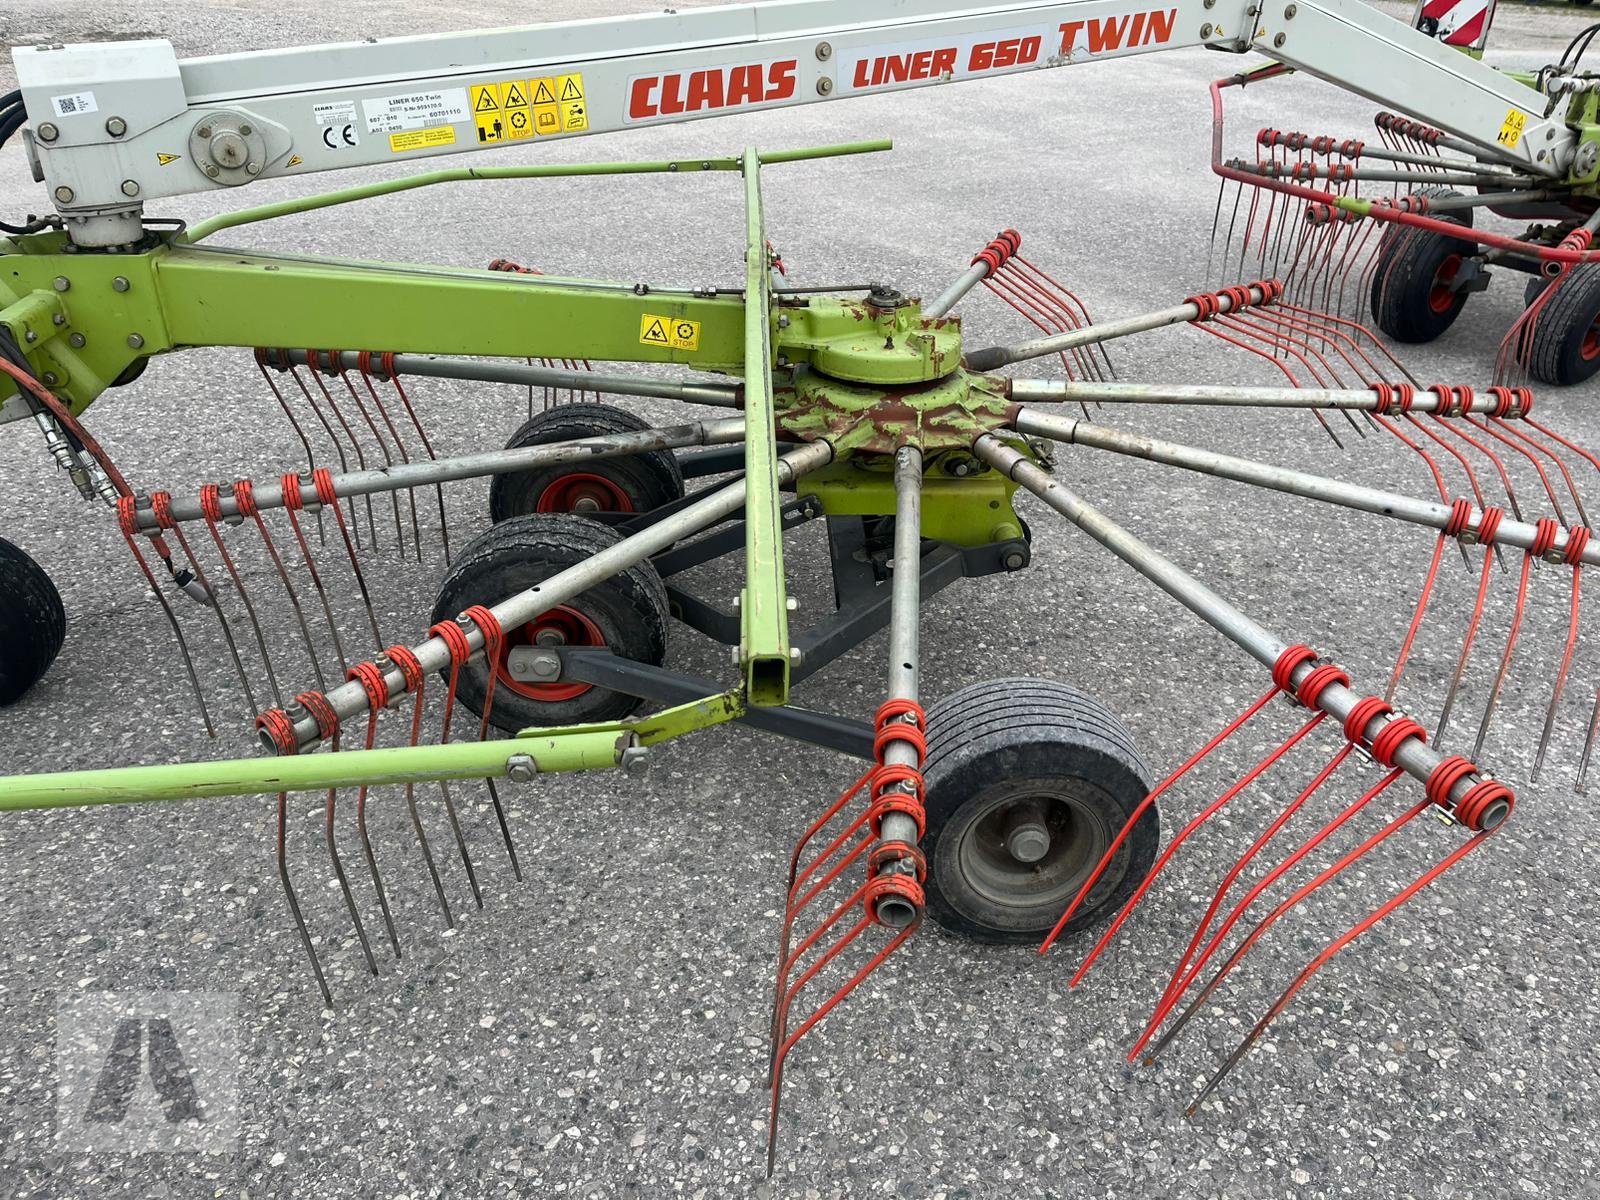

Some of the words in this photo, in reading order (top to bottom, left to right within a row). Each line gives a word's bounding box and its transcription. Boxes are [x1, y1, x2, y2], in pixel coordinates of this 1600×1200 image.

[852, 47, 957, 88] LINER
[967, 35, 1042, 71] 650
[1058, 8, 1177, 61] TWIN
[629, 59, 797, 119] CLAAS
[388, 97, 410, 106] LINER
[411, 95, 424, 103] 650
[512, 129, 530, 137] STOP
[673, 339, 694, 347] STOP
